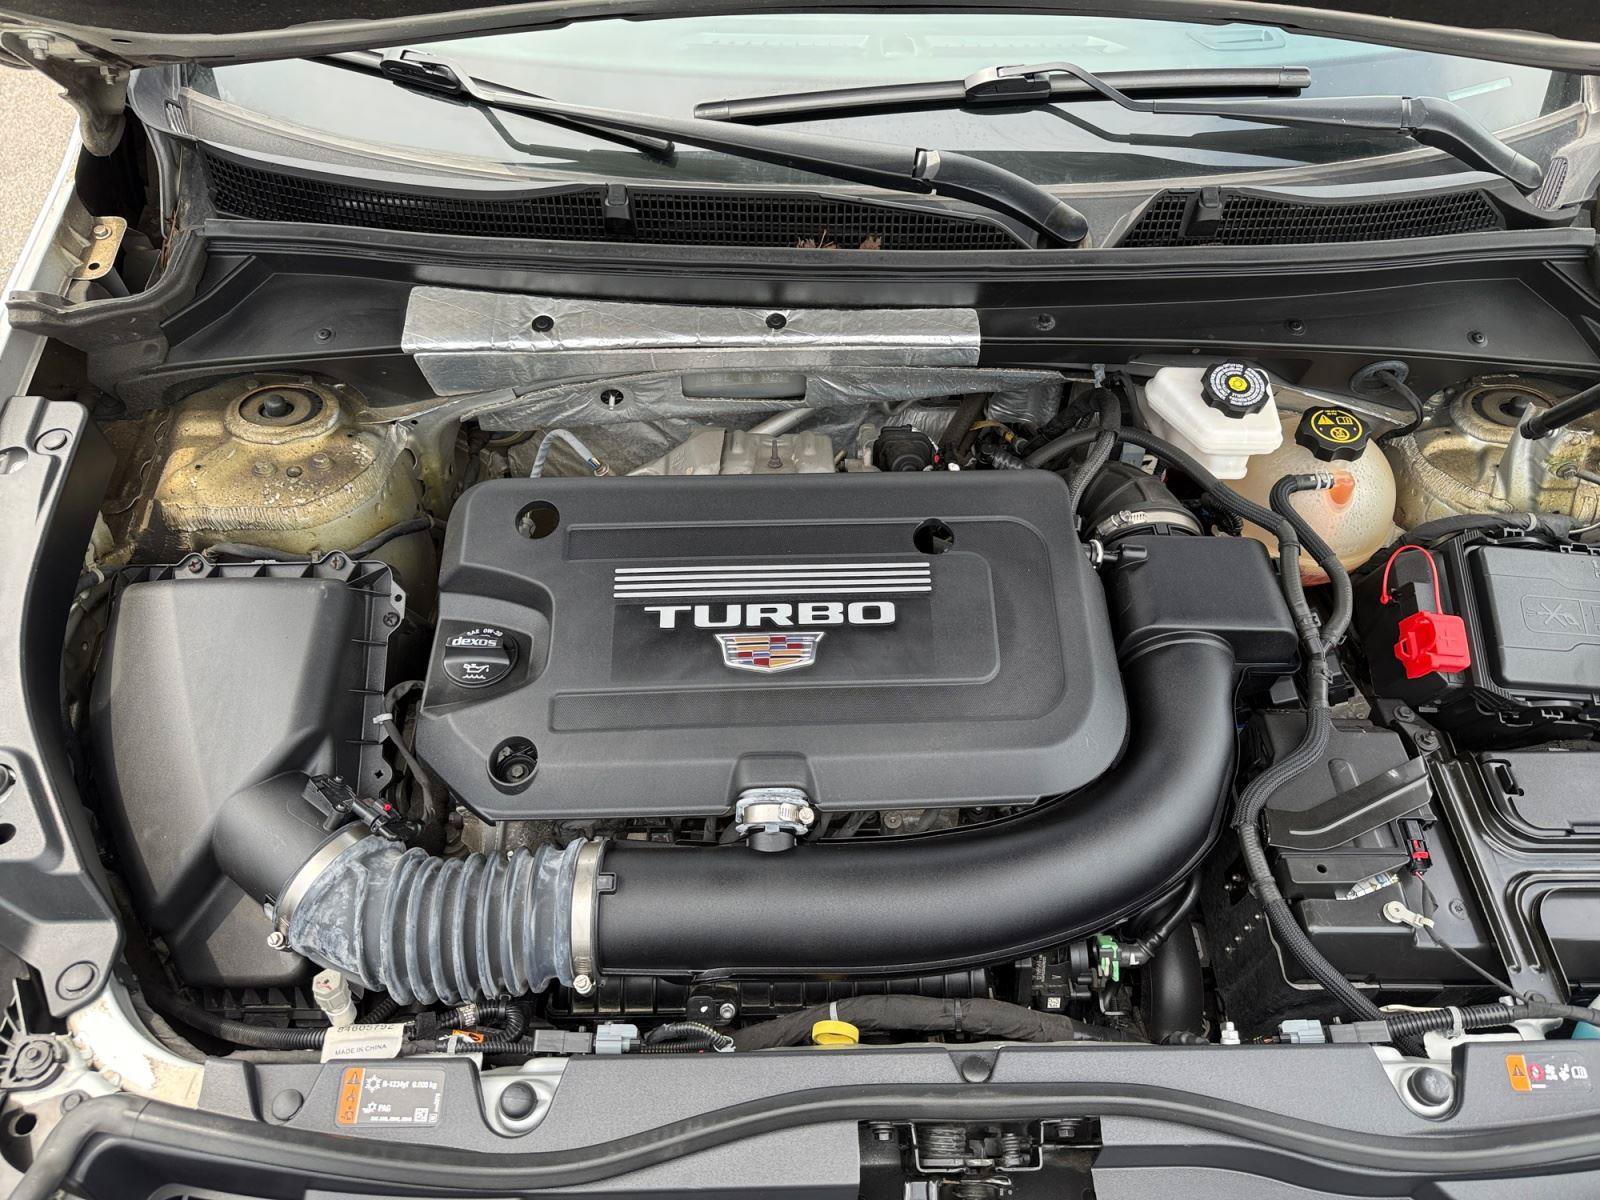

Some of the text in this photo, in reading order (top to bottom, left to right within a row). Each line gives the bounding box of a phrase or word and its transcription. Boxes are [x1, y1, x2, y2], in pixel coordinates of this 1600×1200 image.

[644, 601, 896, 629] TURBO
[451, 637, 498, 647] dexos
[335, 1048, 356, 1056] MADE
[364, 1043, 388, 1053] CHINA
